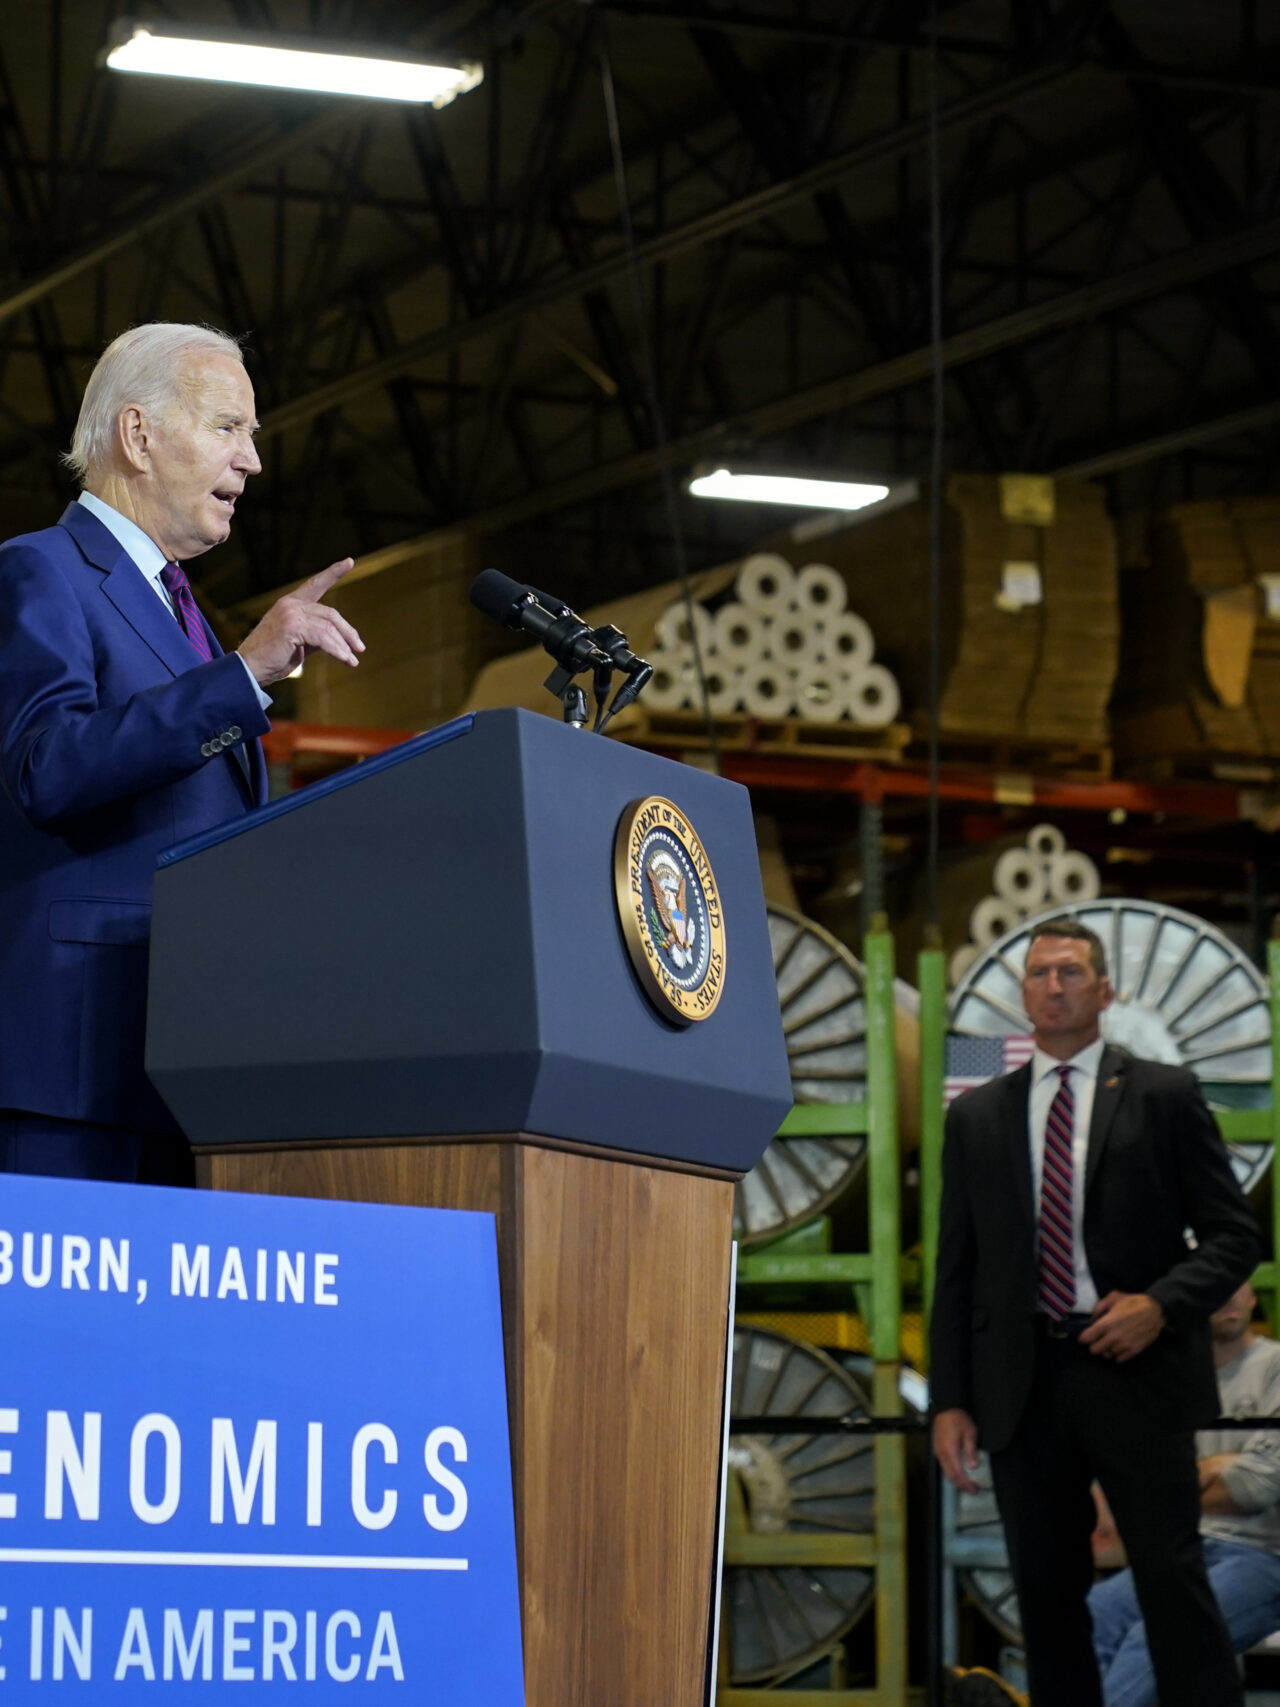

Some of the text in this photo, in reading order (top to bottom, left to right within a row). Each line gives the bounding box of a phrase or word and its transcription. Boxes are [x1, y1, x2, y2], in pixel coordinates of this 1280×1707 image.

[663, 808, 673, 824] OF
[672, 814, 687, 839] THE
[631, 804, 660, 894] PRESIDENT
[689, 837, 720, 930] UNITED
[656, 958, 682, 1007] SEAL
[696, 948, 722, 1011] STATES
[170, 1242, 340, 1306] MAINE
[30, 1608, 93, 1681] IN
[115, 1609, 405, 1682] AMERICA
